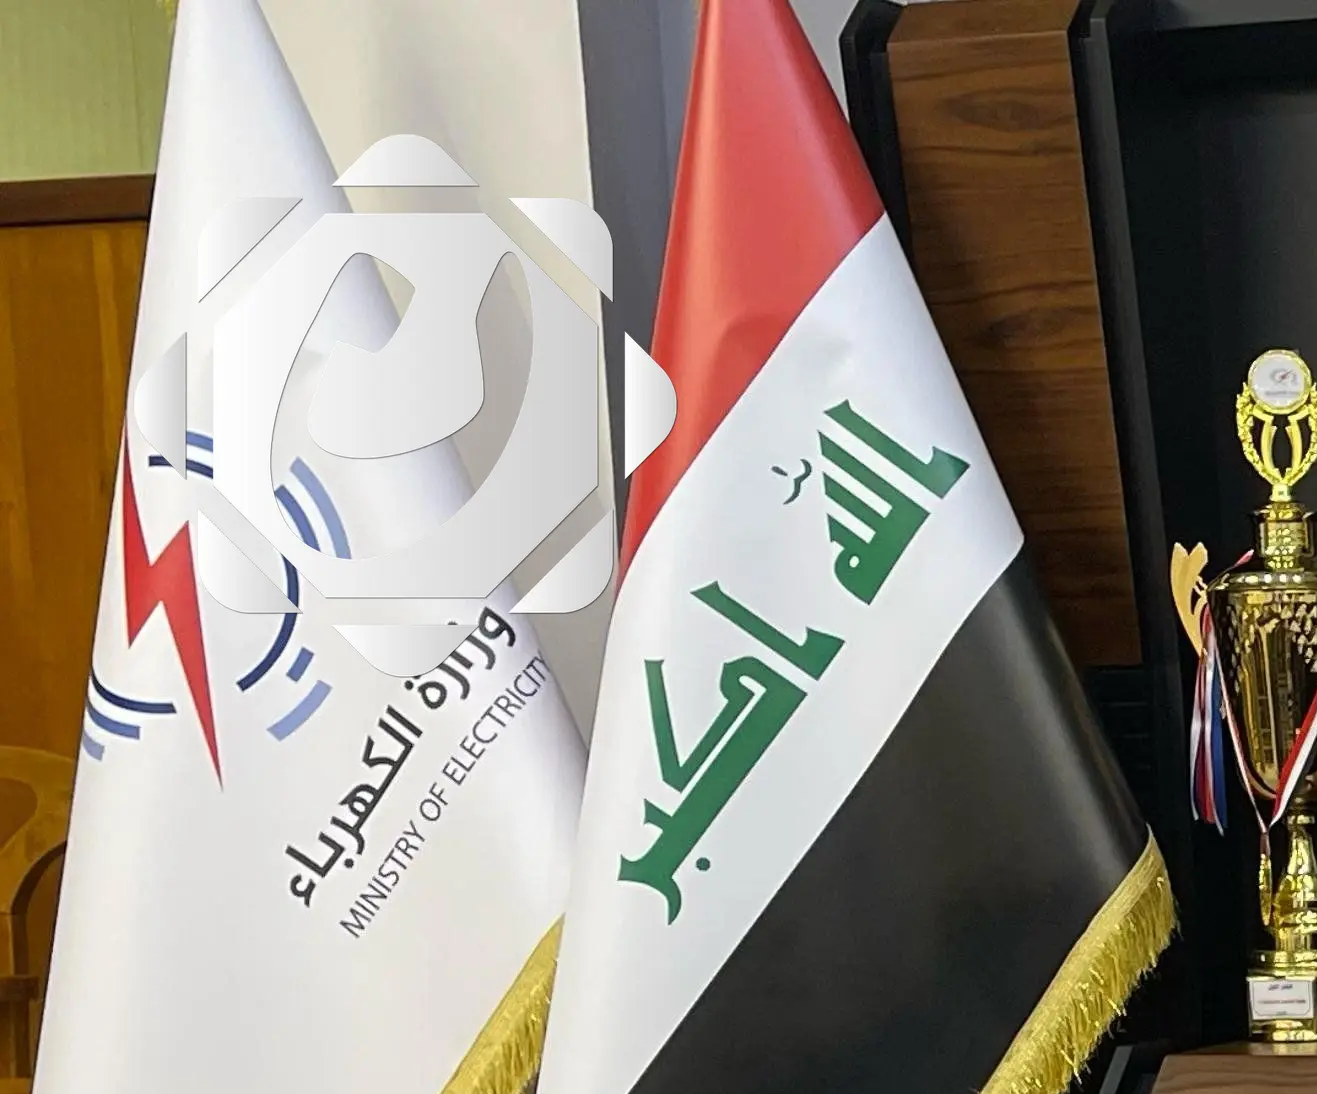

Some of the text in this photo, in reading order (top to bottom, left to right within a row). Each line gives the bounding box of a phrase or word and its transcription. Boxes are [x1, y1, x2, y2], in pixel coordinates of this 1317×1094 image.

[771, 398, 972, 606] الله
[284, 703, 424, 908] الكهرباء
[338, 650, 553, 939] MINISTRY OF ELECTRICITY
